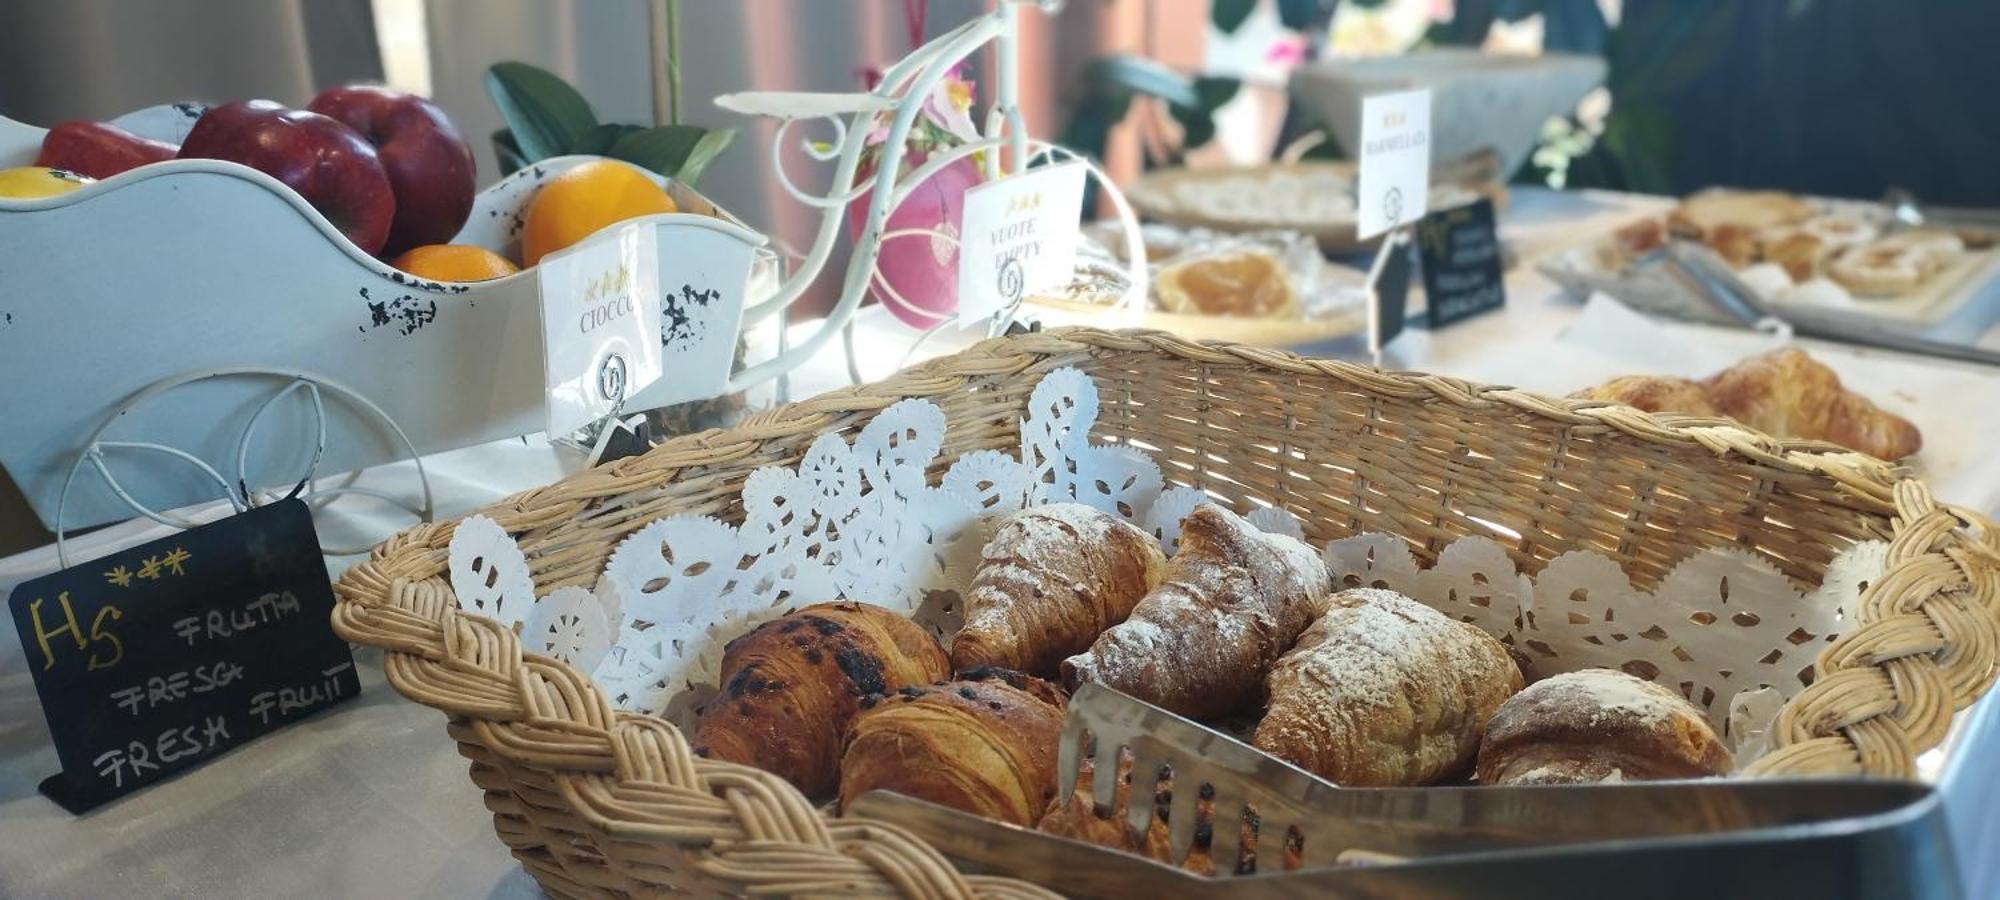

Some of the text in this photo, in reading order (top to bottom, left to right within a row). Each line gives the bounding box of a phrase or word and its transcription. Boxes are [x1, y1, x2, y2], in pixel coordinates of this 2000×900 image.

[991, 217, 1036, 245] VUOTE
[172, 590, 301, 646] FRUTTA
[93, 662, 352, 787] FRESH FRUIT
